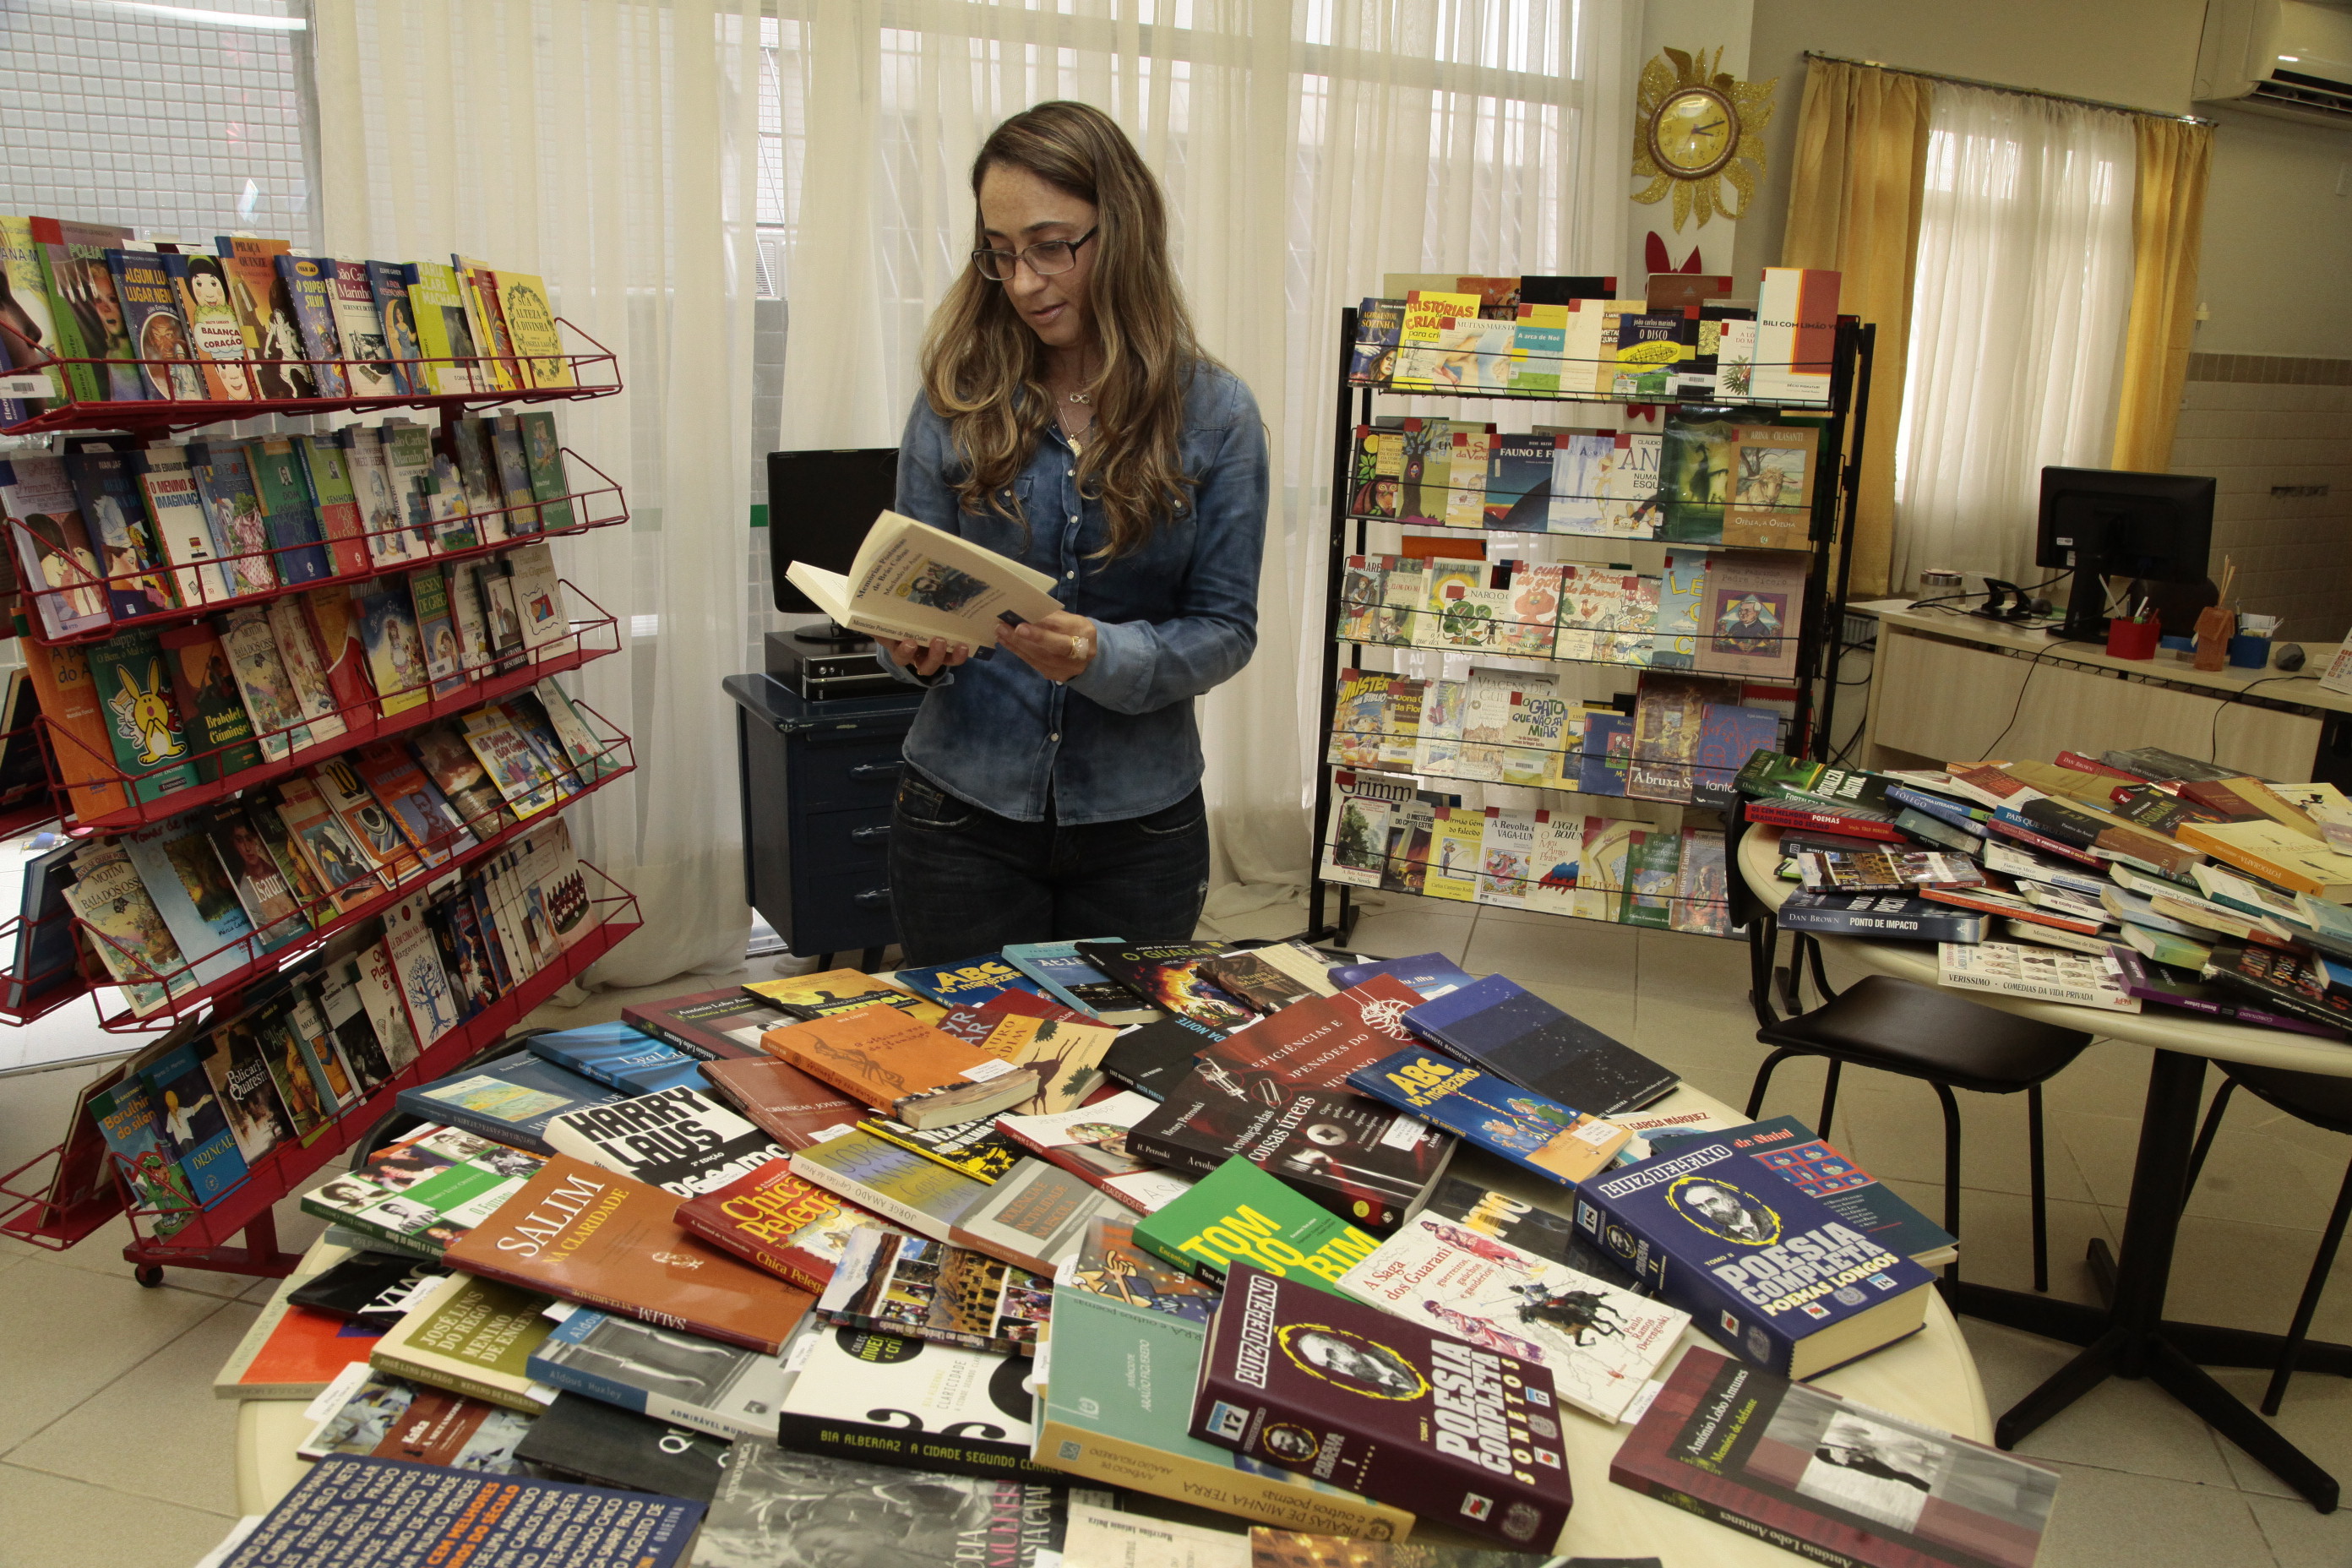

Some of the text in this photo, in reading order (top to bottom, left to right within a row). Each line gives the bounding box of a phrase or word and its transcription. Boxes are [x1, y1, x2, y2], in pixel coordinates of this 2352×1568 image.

[235, 242, 261, 255] PRAÇA
[239, 257, 268, 268] QUINZE
[126, 268, 154, 286] ALGUM
[303, 280, 326, 294] SUPER
[421, 277, 448, 292] CLARA
[127, 287, 154, 302] LUGAR
[305, 295, 324, 308] SILVA
[338, 284, 373, 299] Marinho
[518, 297, 532, 308] SUA
[516, 308, 542, 319] ALTEZA
[1407, 301, 1475, 318] HISTÓRIAS
[201, 327, 240, 337] BALANÇA
[516, 320, 549, 331] A DIVINHA
[1456, 321, 1507, 331] MUITAS MÃES
[1634, 318, 1644, 326] joão
[1645, 318, 1658, 327] carlos
[1800, 322, 1826, 330] LIMÃO
[204, 338, 242, 348] CORAÇÃO
[1408, 330, 1428, 340] para
[1639, 329, 1668, 340] O DISCO
[1500, 448, 1543, 458] FAUNO E
[98, 460, 122, 469] IVAN JAF
[156, 480, 188, 493] MENINO
[857, 564, 882, 599] Memórias
[884, 569, 905, 596] Machado
[852, 619, 876, 630] Memórias
[875, 625, 897, 635] Póstumas
[1478, 677, 1545, 694] VIAGENS DE
[1529, 700, 1564, 715] GATO
[1512, 713, 1550, 725] QUE NÃO
[1528, 725, 1558, 738] MIAR
[325, 761, 358, 798] 10
[1634, 771, 1680, 787] A bruxa
[1742, 781, 1781, 798] DAN BROWN
[1338, 779, 1412, 802] Grimm
[1895, 790, 1927, 808] FÔLEGO
[1500, 821, 1529, 831] Revolta
[1552, 820, 1579, 831] LYGIA
[1776, 808, 1840, 825] MELHORES POEMAS
[2006, 812, 2040, 830] PAIS QUE
[1458, 827, 1480, 836] Falecido
[1547, 847, 1568, 856] Amigo
[91, 865, 125, 885] MOTIM
[102, 887, 121, 901] DOS
[1788, 913, 1839, 924] DAN BROWN
[1849, 917, 1919, 931] PONTO DE IMPACTO
[394, 944, 417, 961] Margaret
[1143, 947, 1222, 961] GUARANI
[937, 961, 1012, 988] ABC
[1948, 974, 2093, 1002] VERISSIMO COMÉDIAS VIDA PRIVADA
[1347, 1033, 1369, 1048] DO
[1422, 1030, 1471, 1064] MANUEL BANDEIRA
[1386, 1058, 1454, 1098] ABC
[558, 1086, 712, 1143] HARRY
[1162, 1101, 1206, 1137] Henry Petroski
[1631, 1111, 1711, 1132] GARCÍA MÁRQUEZ
[1233, 1109, 1275, 1149] evolução das
[1754, 1129, 1795, 1145] Natal
[192, 1134, 236, 1170] BRINCAR
[593, 1120, 725, 1173] LAUS
[1145, 1145, 1171, 1159] Petroski
[700, 1151, 725, 1166] EDIÇÃO
[1599, 1144, 1734, 1199] LUIZ DELFINO
[721, 1176, 813, 1223] Chica
[855, 1188, 917, 1223] JORGE AMADO
[1015, 1184, 1068, 1233] INCIVILIDADE
[496, 1173, 606, 1258] SALIM
[736, 1188, 842, 1244] Pelega
[1045, 1199, 1078, 1228] ESCOLA
[542, 1187, 630, 1267] NA CLARIDADE
[1178, 1204, 1282, 1267] TOM
[1158, 1245, 1191, 1267] Encontros
[1704, 1255, 1727, 1267] TOMO
[1712, 1221, 1867, 1291] POESIA
[756, 1250, 827, 1294] Chica Pelega
[1375, 1259, 1406, 1288] Saga
[1387, 1245, 1452, 1302] dos Guarani
[1740, 1239, 1886, 1307] COMPLETA
[1761, 1252, 1900, 1316] POEMAS LONGOS
[420, 1289, 484, 1348] JOSÉ LINS
[437, 1303, 493, 1352] DO REGO
[638, 1307, 688, 1331] SALIM
[1624, 1316, 1643, 1336] Paulo
[461, 1315, 513, 1359] MENINO
[1236, 1276, 1279, 1389] LUIZ DELFINO
[1632, 1319, 1654, 1341] Ramos
[1636, 1315, 1671, 1352] Derengoski
[585, 1379, 623, 1401] Huxley
[1431, 1338, 1473, 1466] POESIA
[1686, 1369, 1749, 1456] António Lobo Antunes
[1477, 1353, 1513, 1475] COMPLETA
[820, 1429, 902, 1452] BIA ALBERNAZ
[1710, 1397, 1758, 1464] Memória elefante
[923, 1445, 1017, 1467] CIDADE SEGUNDO
[336, 1462, 362, 1486] NETO
[340, 1464, 382, 1501] GULLAR
[363, 1467, 400, 1500] PRADO
[381, 1470, 422, 1506] BARROS
[445, 1478, 482, 1516] MENDES
[445, 1481, 502, 1541] MELHORES
[480, 1484, 521, 1528] SÉCULO
[531, 1492, 584, 1549] HENRIQUETA
[1720, 1511, 1769, 1538] Antunes
